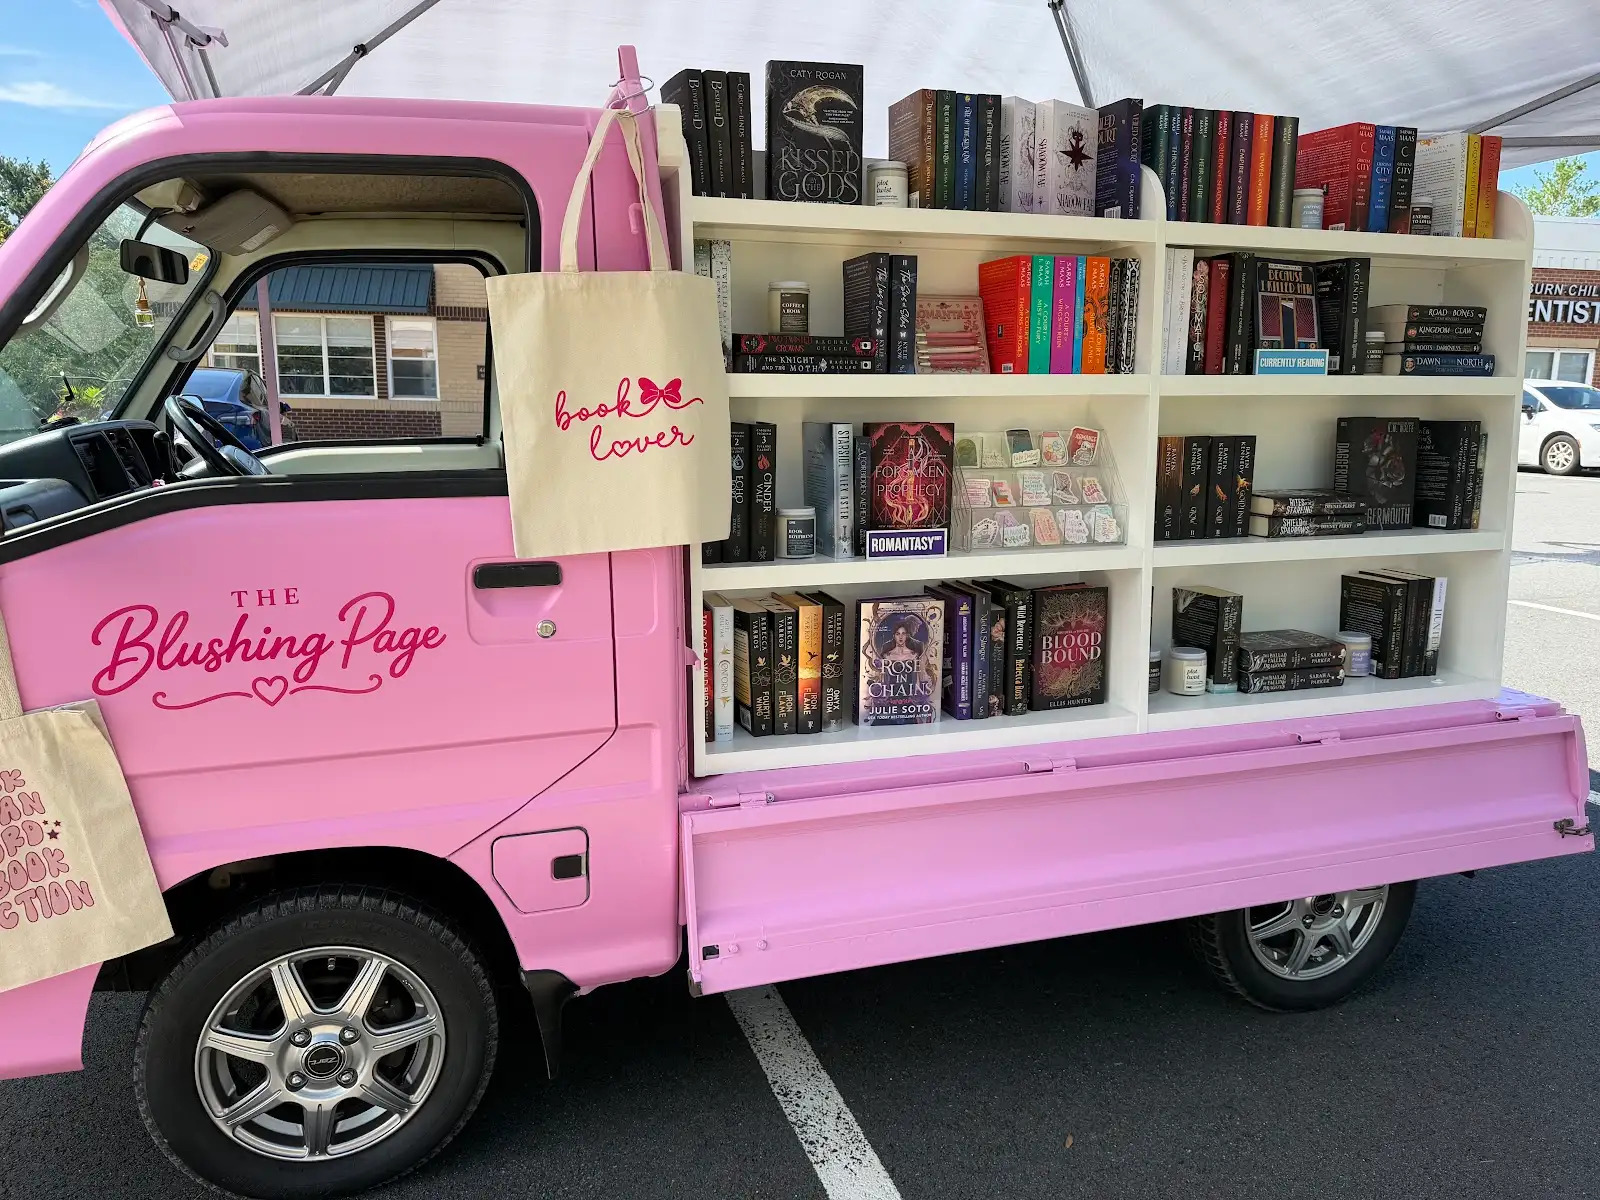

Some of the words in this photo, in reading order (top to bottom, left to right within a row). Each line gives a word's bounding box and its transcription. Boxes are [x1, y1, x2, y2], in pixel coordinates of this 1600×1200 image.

[790, 69, 812, 80] CATY
[815, 70, 847, 82] ROGAN
[1359, 130, 1374, 139] MAAS
[1379, 134, 1395, 142] MAAS
[1399, 134, 1415, 142] MAAS
[1000, 135, 1011, 169] SHADOW
[1037, 138, 1048, 171] SHADOW
[1130, 137, 1138, 163] COURT
[780, 147, 860, 176] KISSED
[1170, 146, 1178, 176] THRONE
[1238, 148, 1246, 174] EMPIRE
[1258, 152, 1266, 177] TOWER
[1356, 163, 1371, 171] CITY
[1037, 174, 1047, 188] FAE
[1375, 167, 1390, 176] CITY
[1396, 167, 1412, 176] CITY
[778, 170, 859, 203] GODS
[1181, 177, 1189, 213] MIDNIGHT
[1168, 187, 1176, 209] GLASS
[1215, 180, 1223, 216] SHADOWS
[900, 268, 911, 284] The
[1269, 269, 1303, 282] BECAUSE
[1267, 281, 1295, 294] KILLED
[1297, 283, 1313, 294] HIM
[1351, 261, 1361, 314] ASCENDED
[1568, 284, 1599, 297] CHIL
[899, 308, 910, 329] Silas
[1452, 308, 1474, 317] BONES
[1418, 326, 1450, 334] KINGDOM
[1454, 326, 1474, 335] CLAW
[775, 344, 805, 353] CROWNS
[1087, 336, 1095, 364] FLAMES
[780, 356, 815, 364] KNIGHT
[789, 363, 819, 372] MOTH
[1260, 357, 1297, 368] CURRENTLY
[1297, 358, 1325, 368] READING
[1416, 356, 1442, 366] DAWN
[1456, 357, 1484, 367] NORTH
[555, 378, 640, 433] book
[590, 424, 696, 462] lover
[734, 438, 740, 447] 2
[761, 436, 767, 445] 3
[838, 430, 850, 468] STARSIDE
[1216, 442, 1224, 476] KENNEDY
[875, 465, 945, 479] FORSAKEN
[735, 475, 744, 504] ECHO
[763, 473, 773, 513] CINDER
[876, 483, 943, 497] PROPHECY
[1289, 498, 1305, 507] RITES
[1282, 518, 1303, 528] SHIELD
[1366, 506, 1410, 525] GERMOUTH
[871, 536, 934, 553] ROMANTASY
[229, 586, 300, 609] THE
[1016, 605, 1027, 619] Wild
[752, 620, 760, 649] YARROS
[778, 619, 786, 648] YARROS
[827, 615, 835, 644] YARROS
[1015, 619, 1026, 651] Reverence
[91, 603, 336, 697] Blushing
[337, 590, 448, 680] Page
[978, 635, 988, 662] Slinger
[1041, 631, 1102, 650] BLOOD
[1041, 645, 1102, 665] BOUND
[1311, 657, 1331, 665] PARKER
[881, 658, 923, 677] ROSE
[1015, 659, 1025, 685] Rebecca
[896, 674, 907, 683] IN
[826, 687, 834, 713] STORM
[833, 690, 841, 710] ONYX
[868, 682, 933, 698] CHAINS
[1014, 685, 1024, 700] Ross
[755, 696, 763, 717] WING
[762, 691, 771, 720] FOURTH
[778, 690, 787, 718] FLAME
[803, 687, 811, 715] FLAME
[810, 692, 818, 710] IRON
[869, 705, 898, 715] JULIE
[901, 703, 931, 714] SOTO
[1049, 700, 1066, 708] ELLIS
[1067, 697, 1092, 706] HUNTER
[0, 768, 26, 793] K
[0, 819, 45, 864] RD
[0, 846, 70, 900] BOOK
[0, 879, 95, 929] CTION
